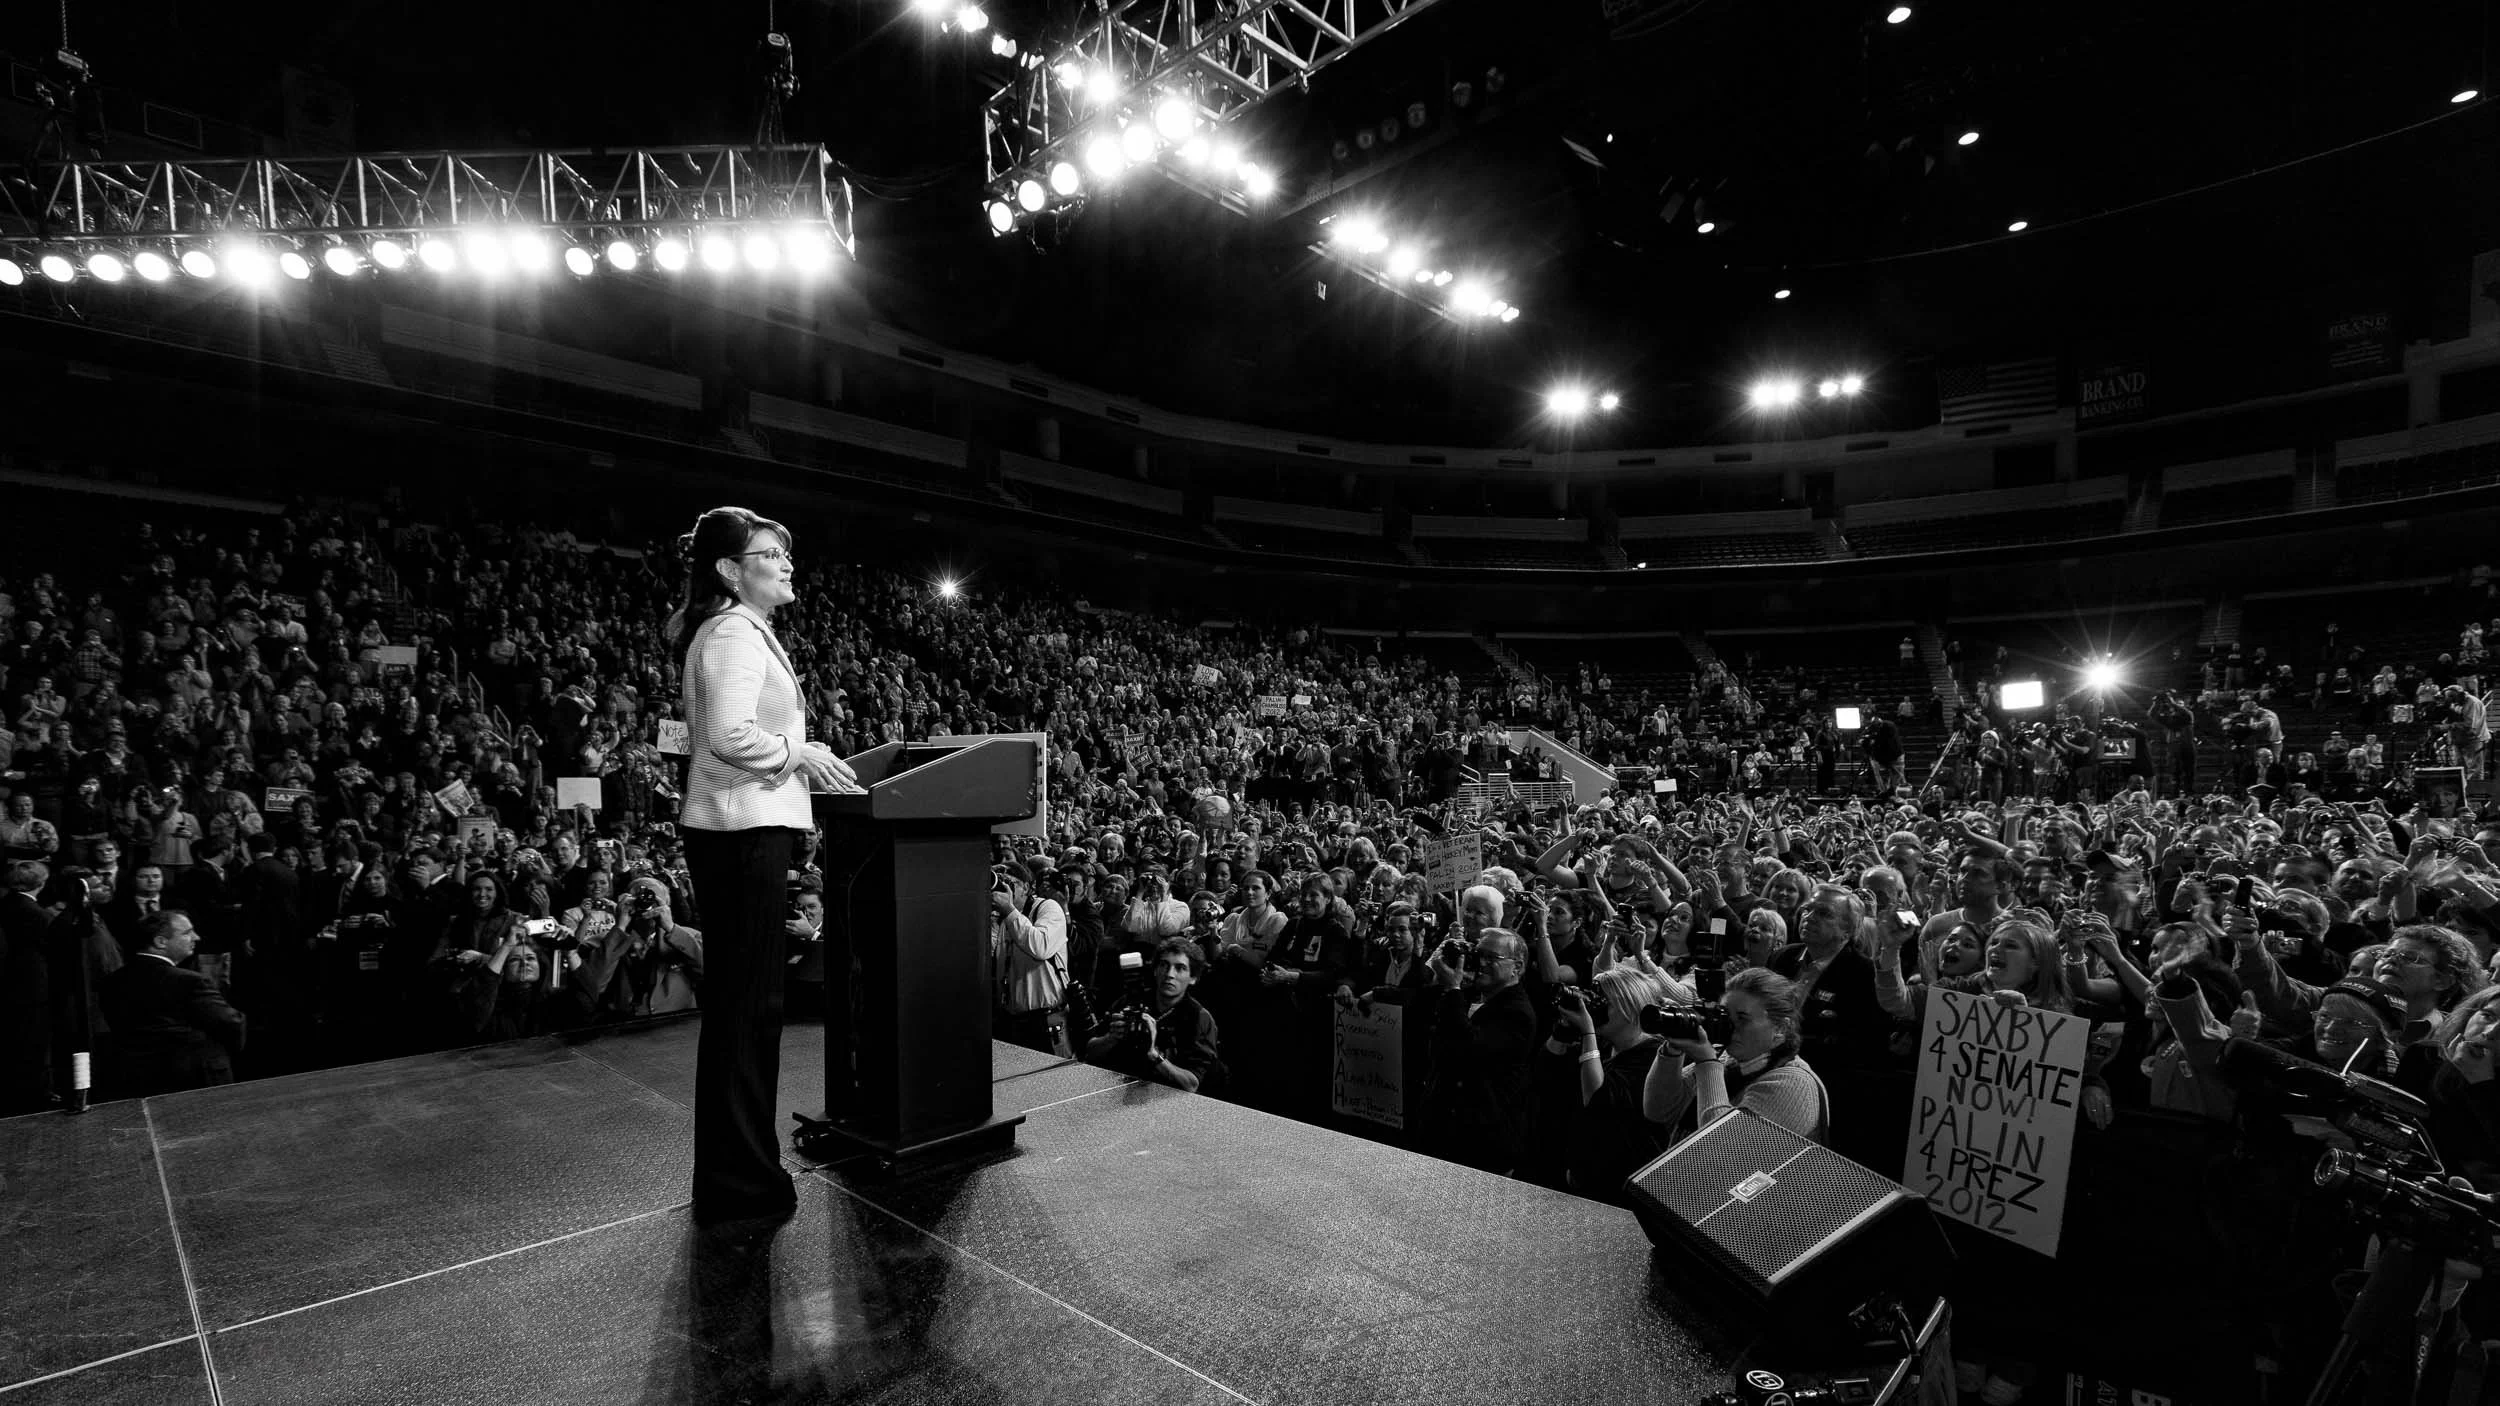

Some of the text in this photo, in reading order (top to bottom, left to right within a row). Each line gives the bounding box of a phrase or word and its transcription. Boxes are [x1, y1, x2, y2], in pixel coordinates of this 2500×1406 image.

[2081, 372, 2146, 403] BRAND
[661, 725, 685, 738] VOTE
[1458, 862, 1480, 873] 2012
[1936, 991, 2067, 1062] SAXBY
[1929, 1035, 2080, 1108] 4 SENATE
[1947, 1075, 2037, 1124] NOW!
[1919, 1096, 2045, 1173] PALIN
[1919, 1140, 2046, 1213] 4 PREZ
[1925, 1174, 2017, 1235] 2012
